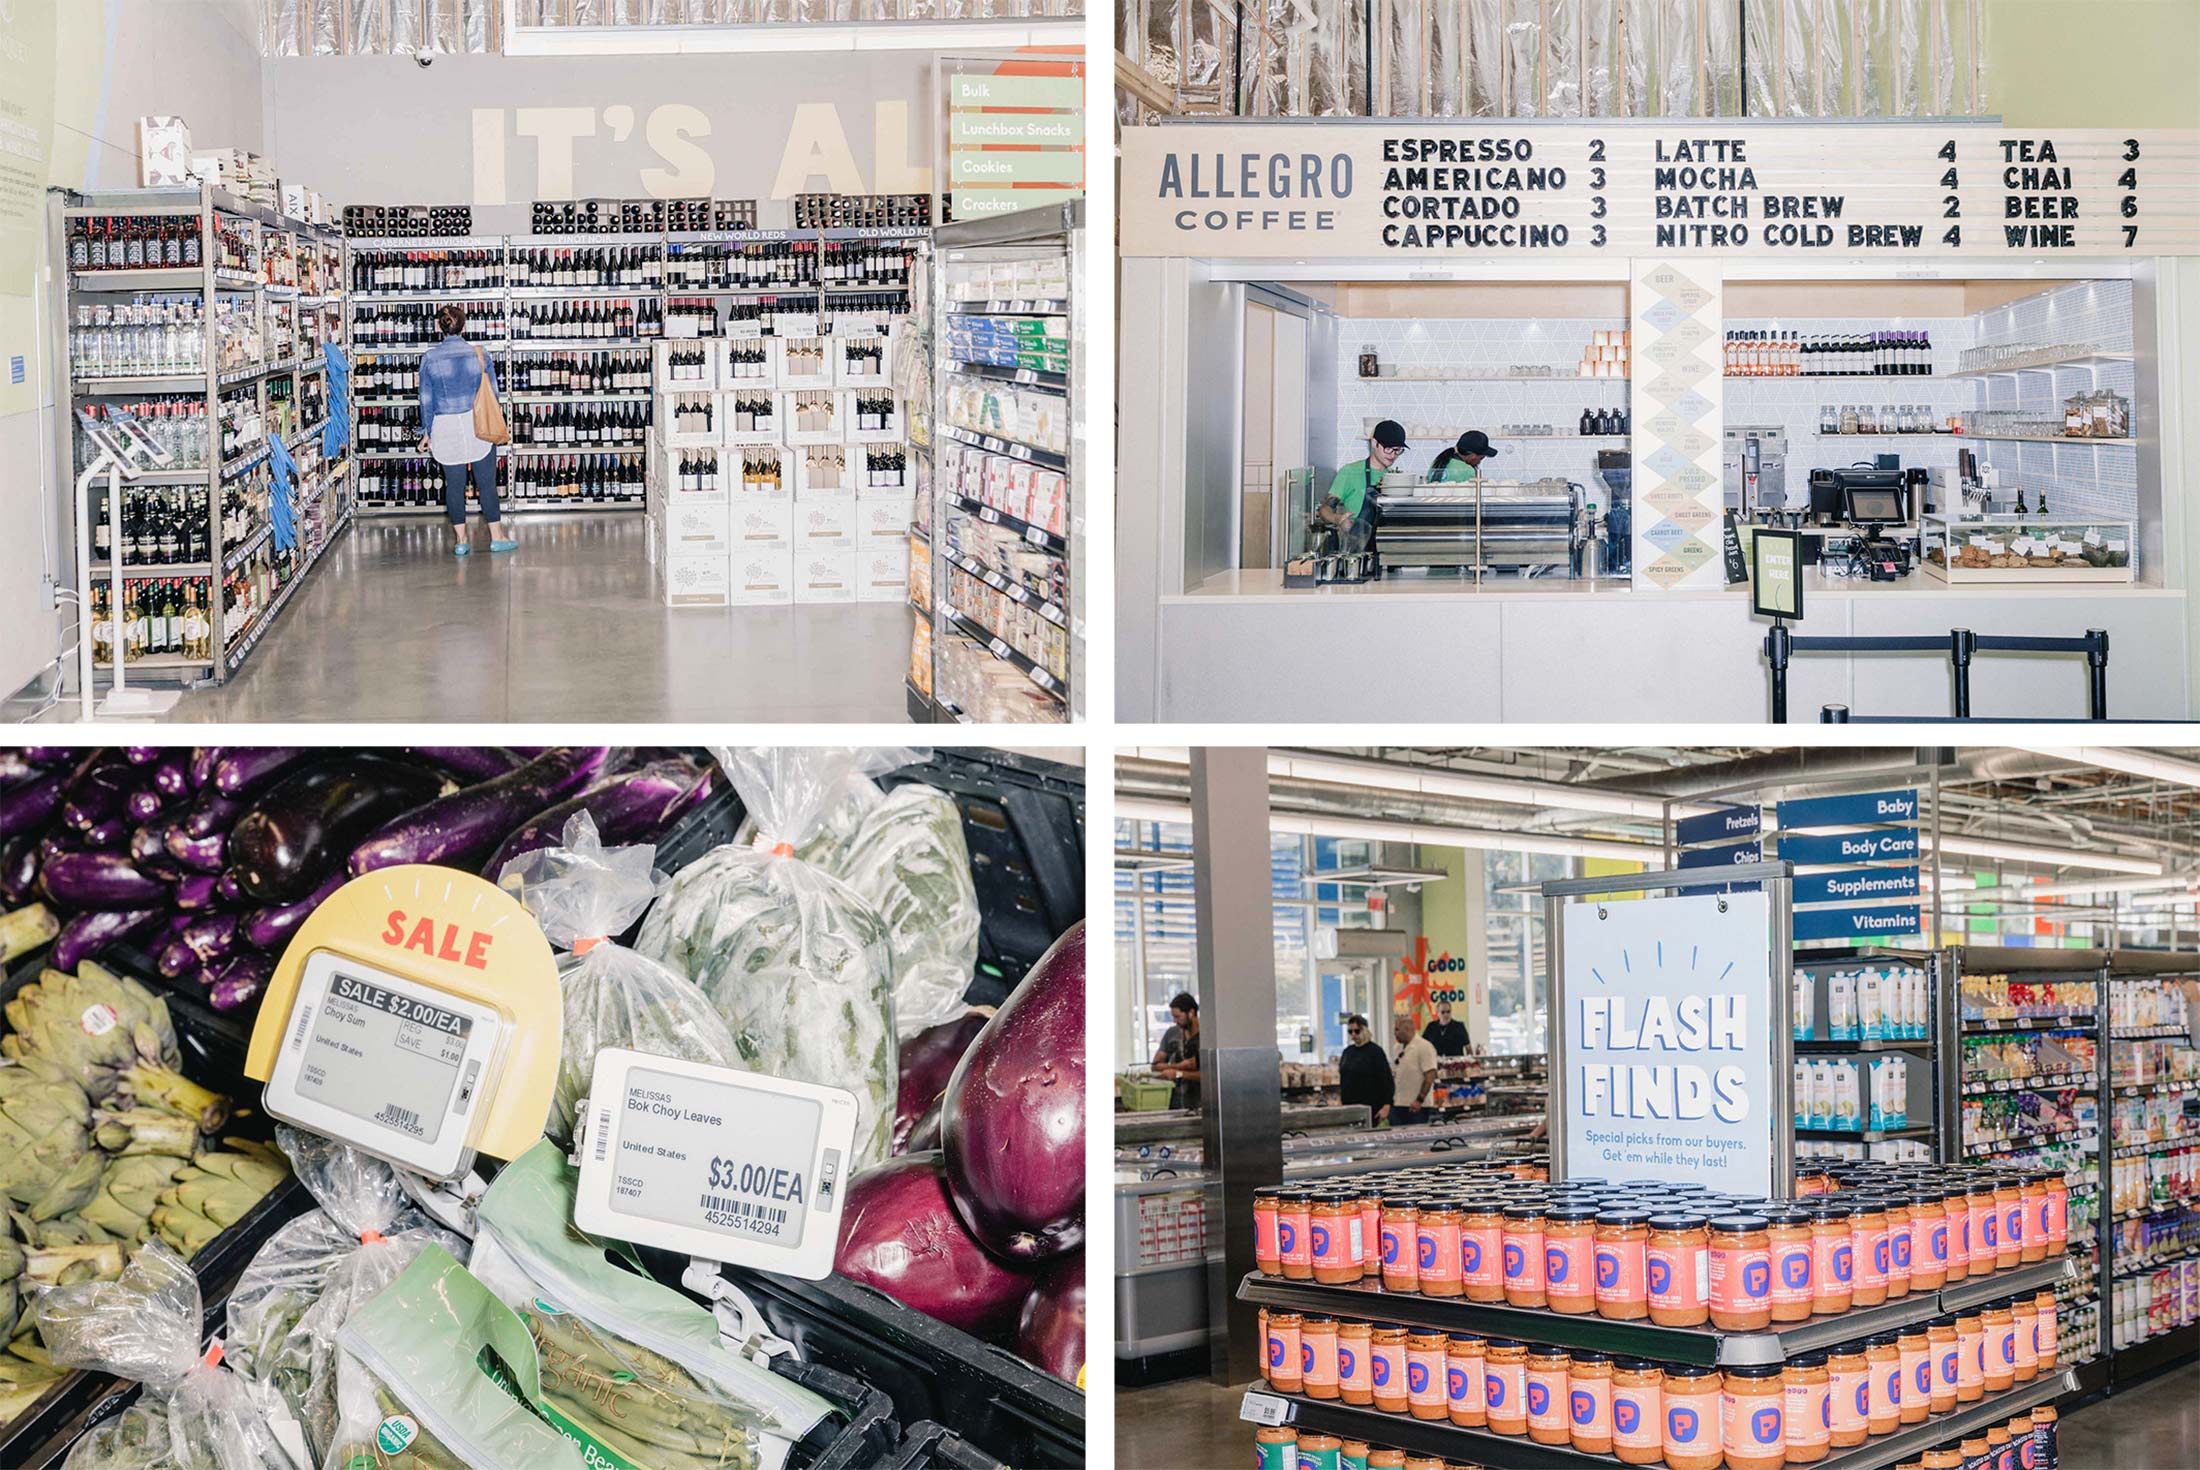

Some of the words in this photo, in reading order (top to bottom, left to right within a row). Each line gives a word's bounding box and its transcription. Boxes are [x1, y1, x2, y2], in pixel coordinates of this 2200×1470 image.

[962, 84, 990, 97] Bulk
[962, 123, 1023, 135] Lunchbox
[1027, 123, 1071, 136] Snacks
[472, 104, 715, 205] IT'S
[1383, 139, 1534, 163] ESPRESSO
[1588, 139, 1607, 162] 2
[1655, 139, 1746, 163] LATTE
[1938, 140, 1957, 162] 4
[2001, 139, 2057, 163] TEA
[2122, 139, 2140, 162] 3
[962, 160, 1013, 173] Cookies
[1158, 152, 1354, 199] ALLEGRO
[1383, 167, 1567, 191] AMERICANO
[1590, 167, 1607, 191] 3
[1655, 167, 1759, 191] MOCHA
[1940, 167, 1959, 190] 4
[2003, 167, 2071, 191] CHAI
[2118, 167, 2137, 190] 4
[962, 198, 1018, 211] Crackers
[1383, 195, 1520, 220] CORTADO
[1590, 195, 1607, 219] 3
[1655, 196, 1748, 220] BATCH
[1763, 196, 1845, 219] BREW
[1943, 196, 1960, 219] 2
[2004, 196, 2079, 220] BEER
[2120, 196, 2138, 219] 6
[1174, 210, 1335, 231] COFFEE
[373, 238, 425, 248] CABERNET
[425, 237, 482, 247] SAUVIGNON
[558, 235, 590, 244] PINOT
[700, 232, 718, 241] NEW
[719, 231, 757, 240] WORLD
[758, 230, 786, 240] REDS
[858, 228, 878, 237] OLD
[880, 228, 917, 237] WORLD
[1382, 224, 1569, 249] CAPPUCCINO
[1590, 224, 1607, 248] 3
[1655, 224, 1749, 248] NITRO
[1763, 224, 1834, 247] COLD
[1847, 224, 1924, 248] BREW
[1942, 224, 1961, 247] 4
[2004, 225, 2076, 248] WINE
[2121, 225, 2138, 247] 7
[1769, 569, 1790, 579] HERE
[1877, 799, 1913, 816] Baby
[1726, 815, 1759, 830] Pretzels
[1842, 840, 1877, 857] Body
[1880, 837, 1914, 852] Care
[1827, 876, 1916, 896] Supplements
[1852, 915, 1916, 930] Vitamins
[381, 910, 493, 970] SALE
[1428, 958, 1465, 973] GOOD
[327, 996, 359, 1012] MELISSAS
[338, 979, 387, 1008] SALE
[388, 995, 461, 1035] $2.00/EA
[1430, 989, 1465, 1003] GOOD
[324, 1006, 345, 1023] Choy
[346, 1013, 366, 1028] Sum
[403, 1021, 423, 1034] REG
[1580, 994, 1747, 1052] FLASH
[316, 1034, 340, 1049] United
[340, 1043, 363, 1057] States
[399, 1034, 422, 1049] SAVE
[440, 1049, 460, 1062] $1.00
[629, 1088, 672, 1103] MELISSAS
[1582, 1063, 1750, 1124] FINDS
[627, 1099, 649, 1112] Bok
[652, 1104, 681, 1120] Choy
[684, 1109, 723, 1126] Leaves
[374, 1112, 424, 1137] 4525514295
[622, 1141, 654, 1155] United
[656, 1147, 687, 1161] States
[1585, 1129, 1624, 1145] Special
[1626, 1133, 1654, 1147] picks
[1656, 1133, 1682, 1146] from
[1685, 1137, 1703, 1147] our
[1706, 1134, 1747, 1153] buyers.
[1602, 1149, 1622, 1161] Get
[1645, 1152, 1673, 1165] while
[1676, 1154, 1699, 1170] they
[1703, 1155, 1727, 1168] last!
[617, 1176, 644, 1188] TSSCD
[708, 1156, 803, 1204] $3.00/EA
[616, 1186, 642, 1198] 187407
[705, 1210, 780, 1237] 4525514294
[391, 1420, 412, 1438] USDA
[583, 1444, 623, 1470] Bea
